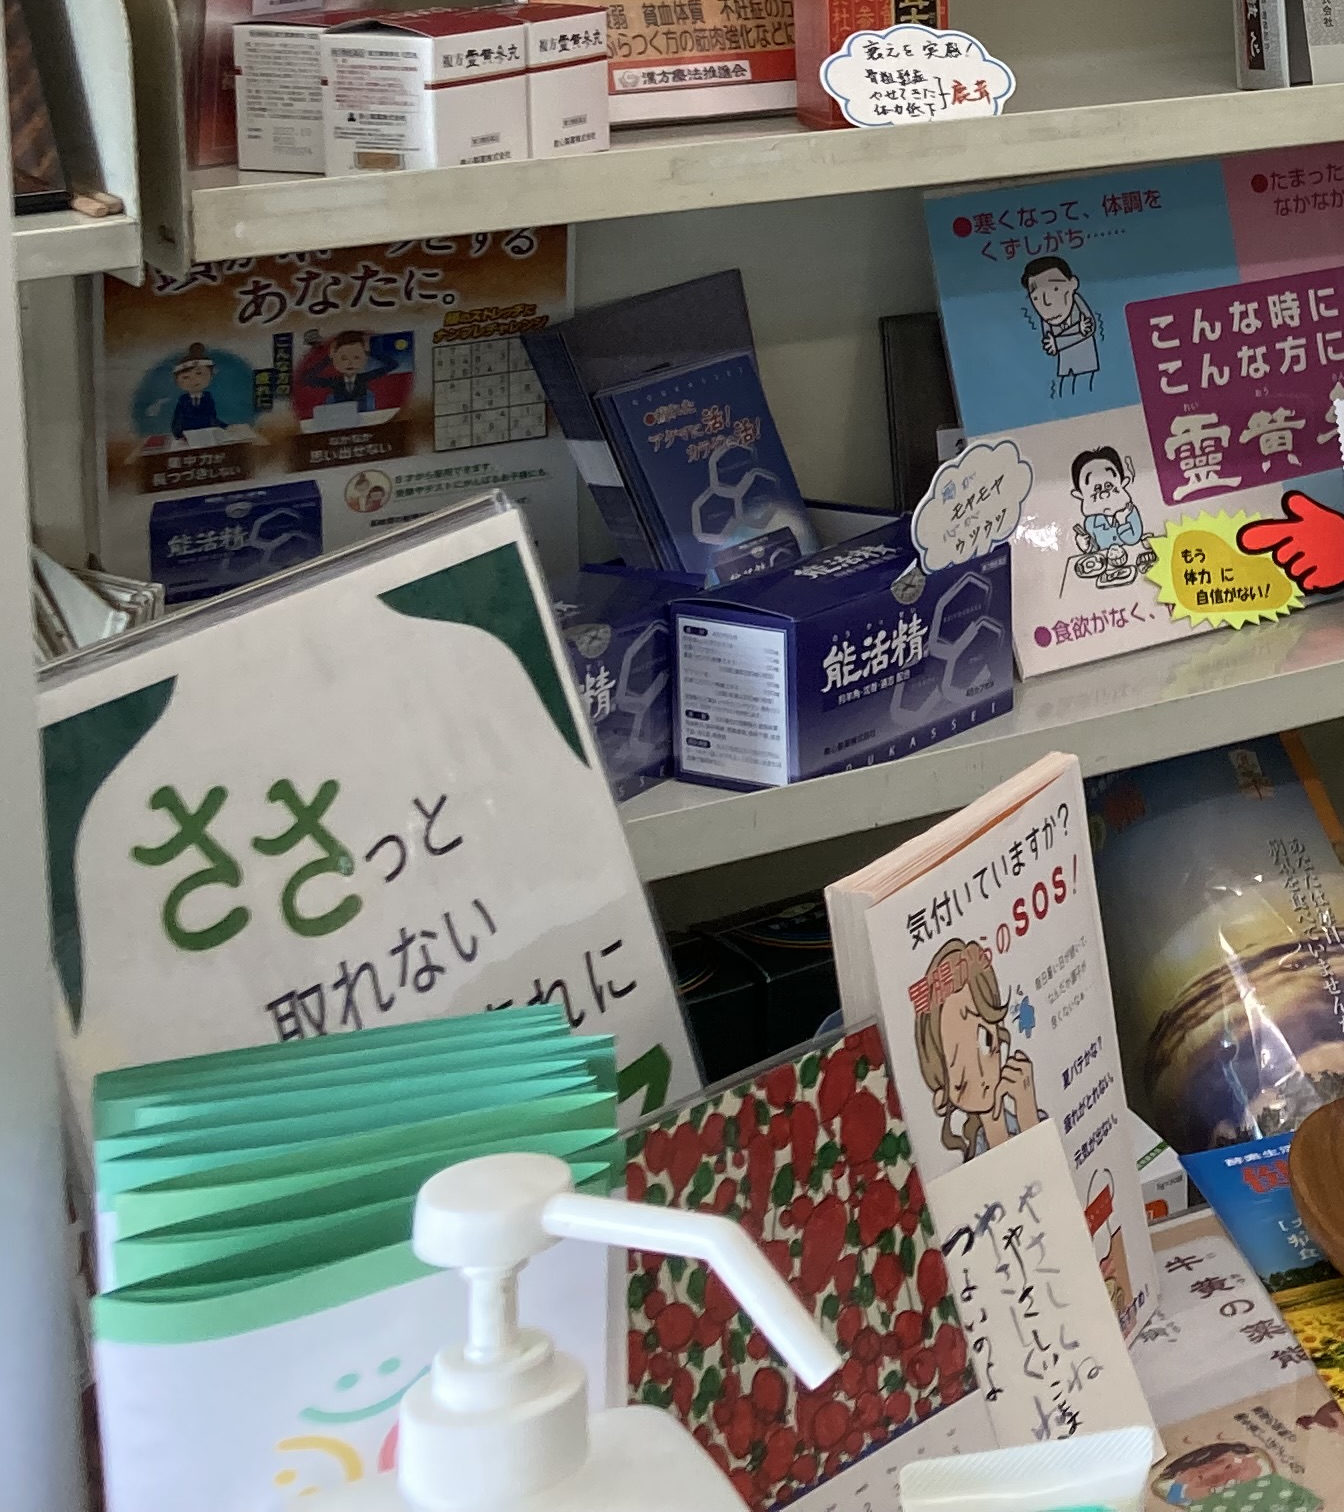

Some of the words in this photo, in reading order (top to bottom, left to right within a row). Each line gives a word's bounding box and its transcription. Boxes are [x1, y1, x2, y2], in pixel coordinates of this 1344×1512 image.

[642, 0, 705, 27] 貧血体質
[973, 190, 1162, 234] 寒くなって、体調を
[238, 265, 456, 324] あなたに。
[1148, 287, 1339, 349] こんな時に
[1181, 549, 1205, 562] もう
[820, 615, 929, 694] 能活精
[131, 778, 463, 952] ささっと
[906, 802, 1070, 950] 気付いていますか?
[265, 898, 498, 1043] 取れない
